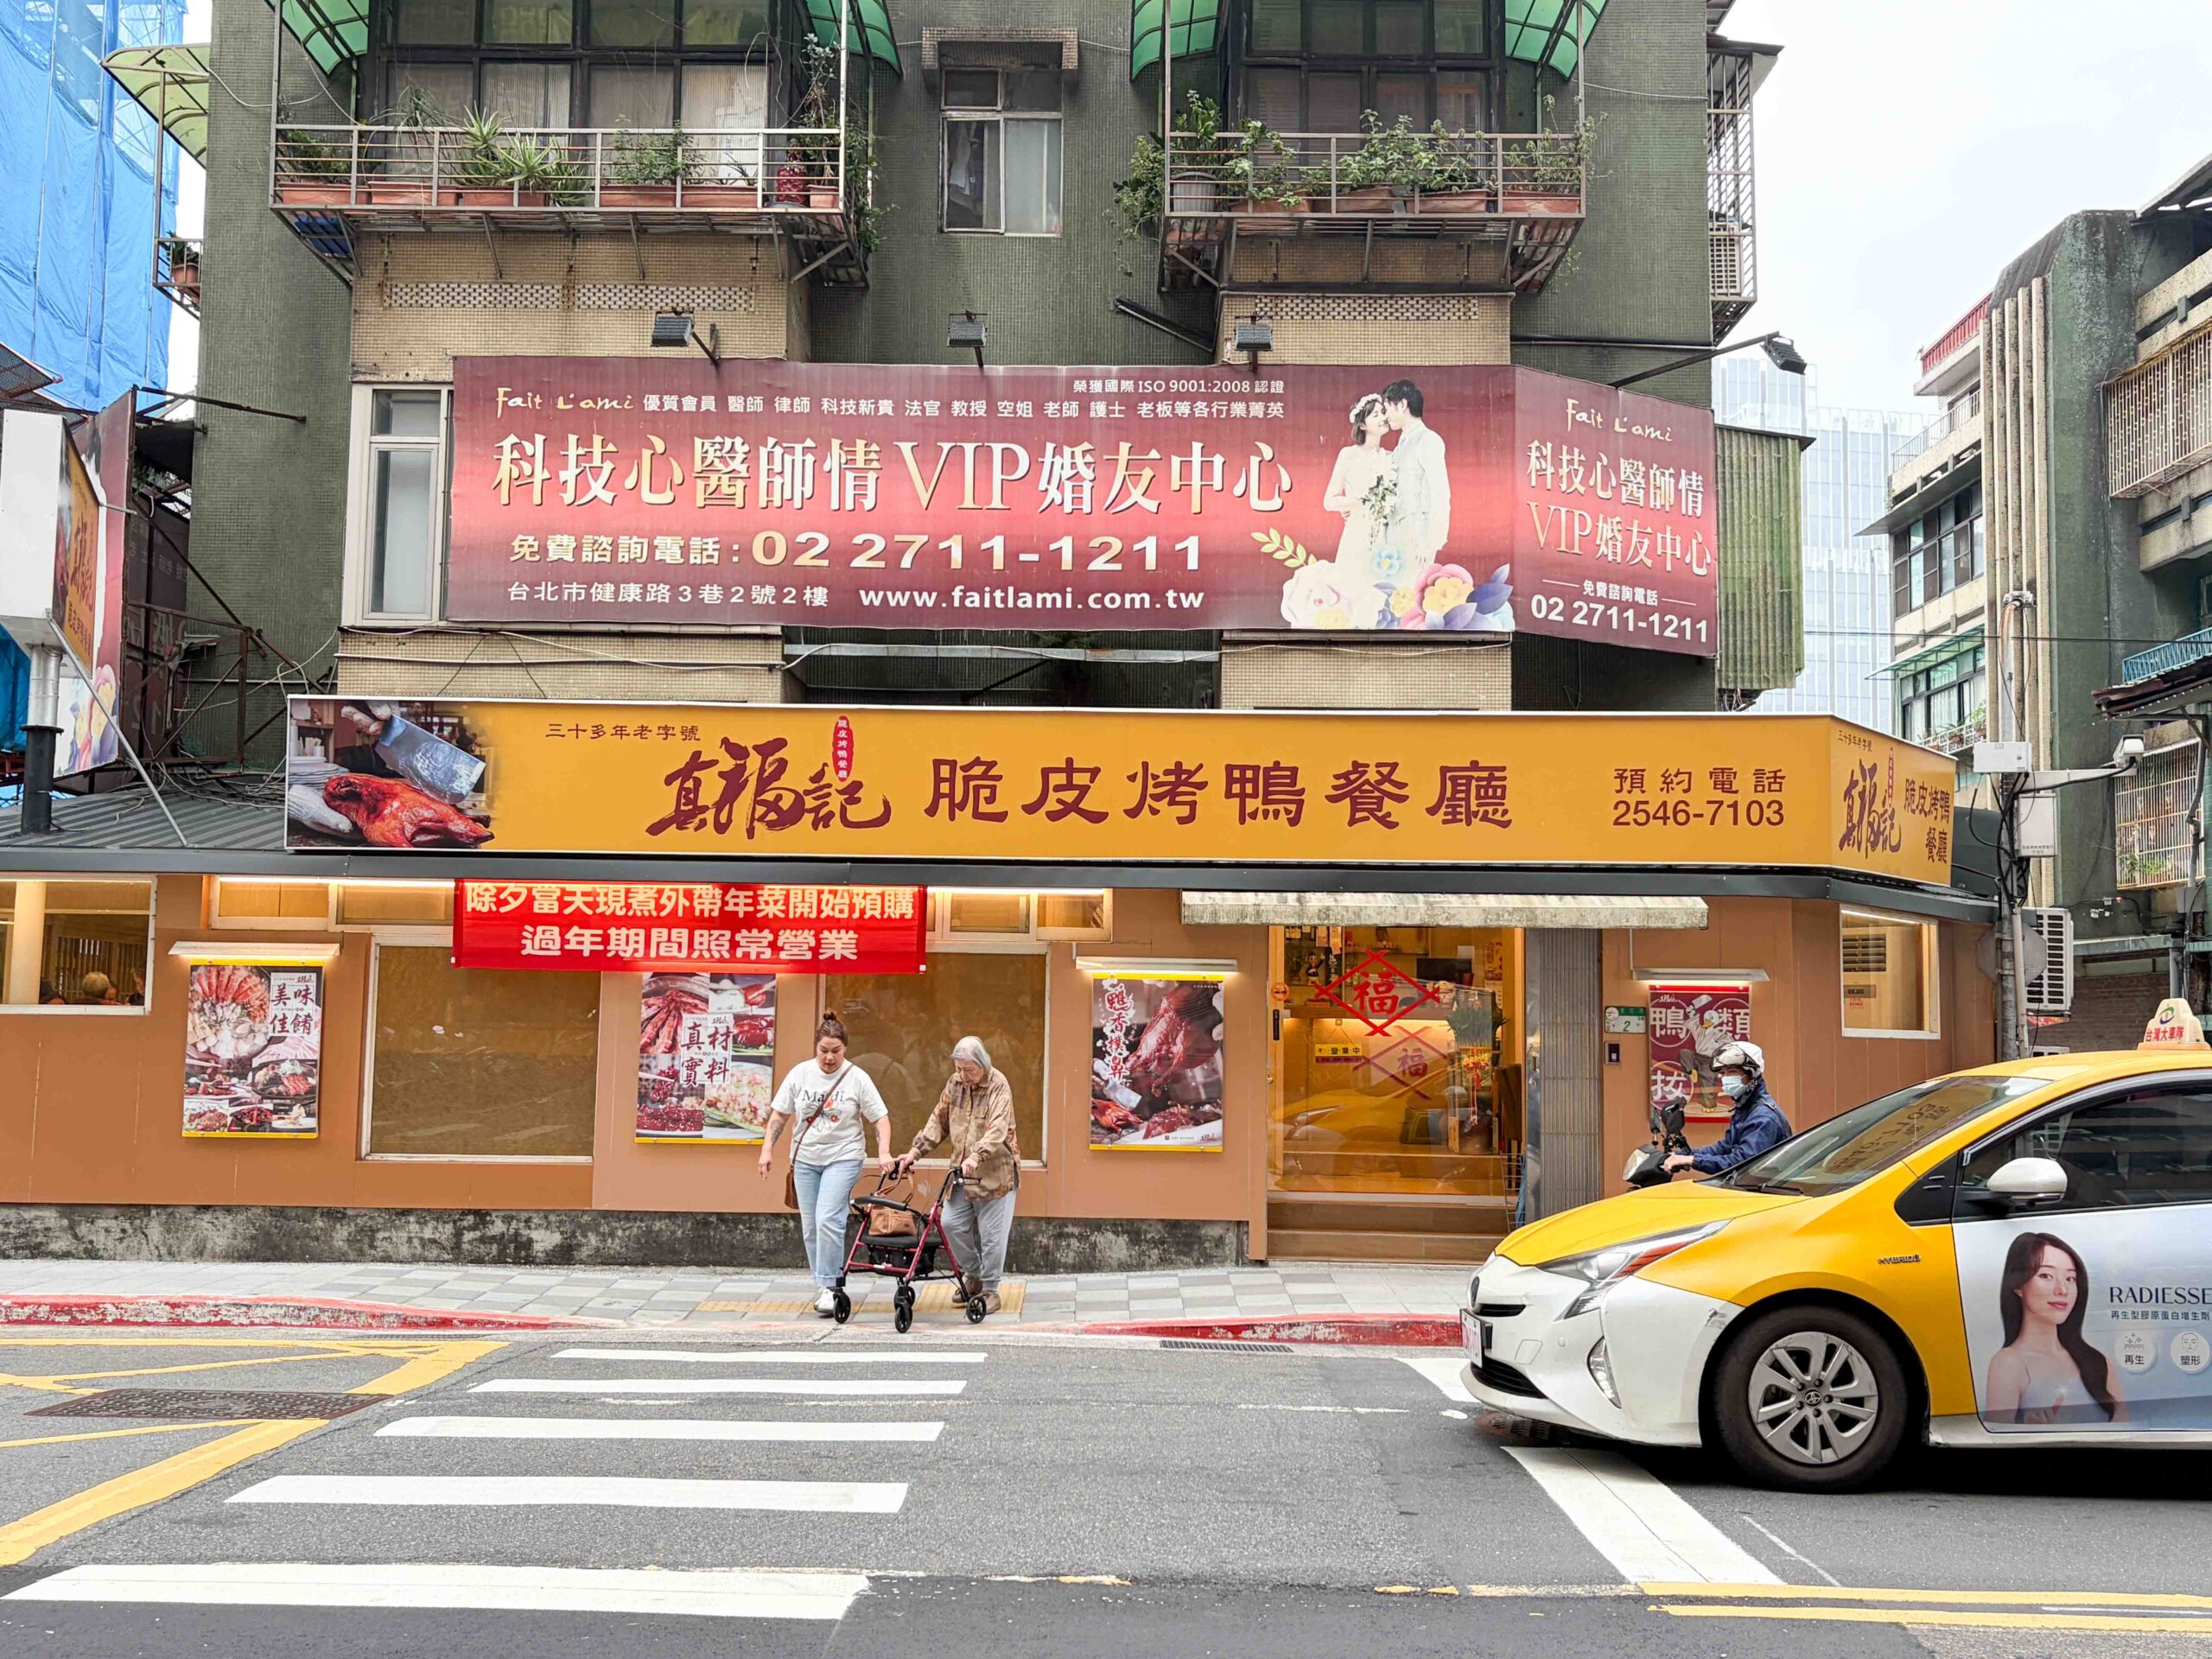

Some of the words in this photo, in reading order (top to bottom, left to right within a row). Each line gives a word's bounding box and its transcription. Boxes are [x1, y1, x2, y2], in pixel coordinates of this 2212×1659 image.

[1073, 379, 1135, 393] 榮獲國際
[1138, 380, 1166, 392] ISO
[1169, 379, 1250, 393] 9001:2008
[1255, 380, 1285, 394] 認證
[496, 386, 543, 419] Fait
[643, 394, 717, 413] 優質會員
[727, 395, 764, 413] 醫師
[774, 395, 810, 414] 律師
[821, 398, 894, 416] 科技新貴
[905, 399, 941, 416] 法官
[950, 400, 987, 416] 教授
[997, 400, 1033, 417] 空姐
[1043, 401, 1079, 417] 老師
[1090, 401, 1125, 418] 護士
[1136, 401, 1285, 418] 老板等各行業菁英
[1565, 398, 1604, 432] Fait
[1527, 439, 1704, 518] 科技心醫師情
[752, 531, 830, 567] 02
[850, 533, 1200, 571] 2711-1211
[1527, 500, 1712, 576] VIP婚友中心
[859, 585, 1205, 609] www.faitlami.com.tw
[1583, 578, 1658, 607] 免費諮詢電話
[1531, 594, 1564, 621] 02
[1572, 601, 1707, 643] 2711-1211
[544, 722, 702, 742] 三十多年老字號
[645, 736, 893, 839] 真福記
[924, 756, 1514, 830] 脆皮烤鴨餐廳
[1612, 767, 1787, 795] 預約電話
[1612, 799, 1785, 827] 2546-7103
[1904, 778, 1950, 824] 脆皮烤鴨
[467, 884, 914, 919] 除夕當天現煮外帶年菜開始預購
[520, 925, 859, 960] 過年期間照常營業
[270, 982, 315, 1007] 美味
[1352, 969, 1400, 1015] 福
[681, 1021, 734, 1052] 真材
[1622, 1020, 1631, 1033] 2
[2145, 1026, 2184, 1042] 台灣大車隊
[681, 1056, 730, 1086] 實料
[802, 1089, 845, 1103] Madi
[2109, 1286, 2212, 1305] RADIESSE
[2124, 1354, 2145, 1365] 再生
[2180, 1355, 2202, 1366] 塑形
